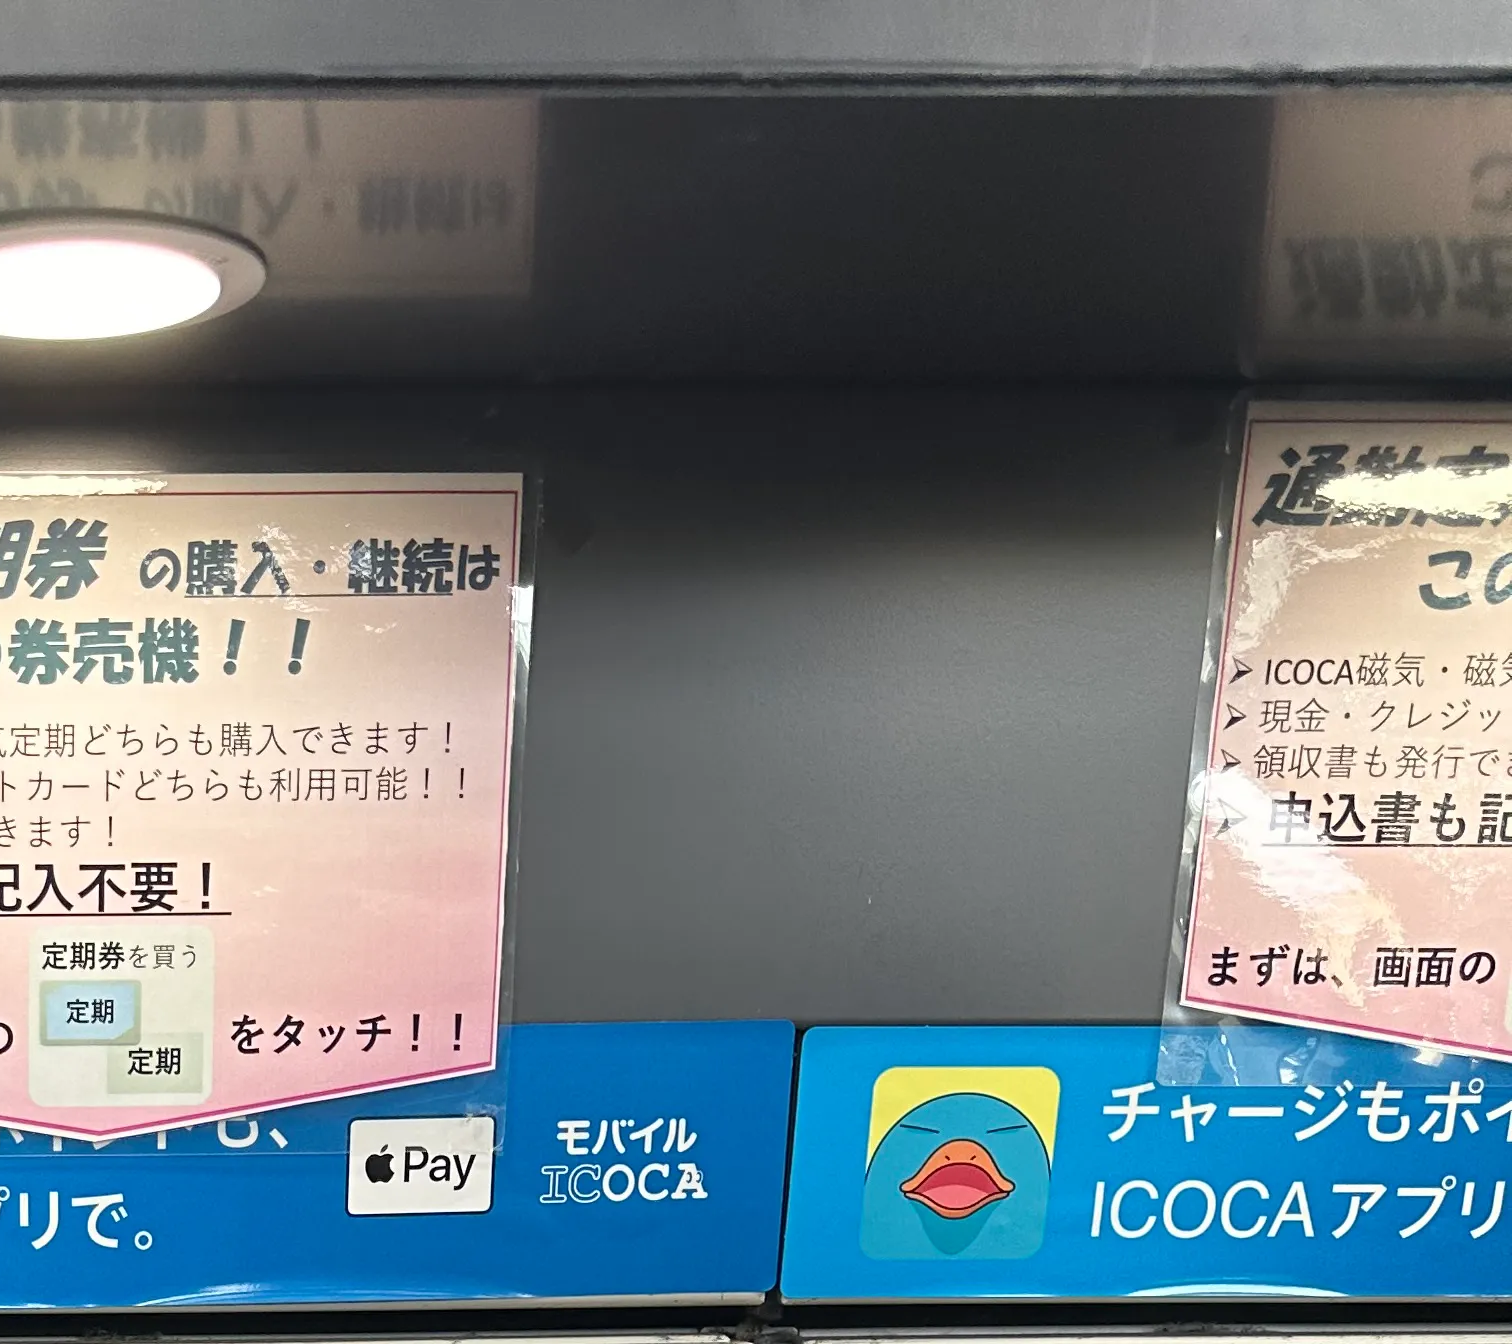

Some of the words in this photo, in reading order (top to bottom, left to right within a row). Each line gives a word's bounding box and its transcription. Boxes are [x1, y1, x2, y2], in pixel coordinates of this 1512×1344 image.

[1254, 744, 1512, 780] 領収書も発行で
[40, 942, 199, 973] 定期券を買う
[1207, 946, 1496, 988] まずは、画面の
[66, 999, 115, 1025] 定期
[230, 1013, 466, 1058] をタッチ！！
[127, 1047, 182, 1075] 定期
[557, 1117, 698, 1155] モバイル
[403, 1145, 477, 1191] Pay
[538, 1162, 708, 1204] ICOCA
